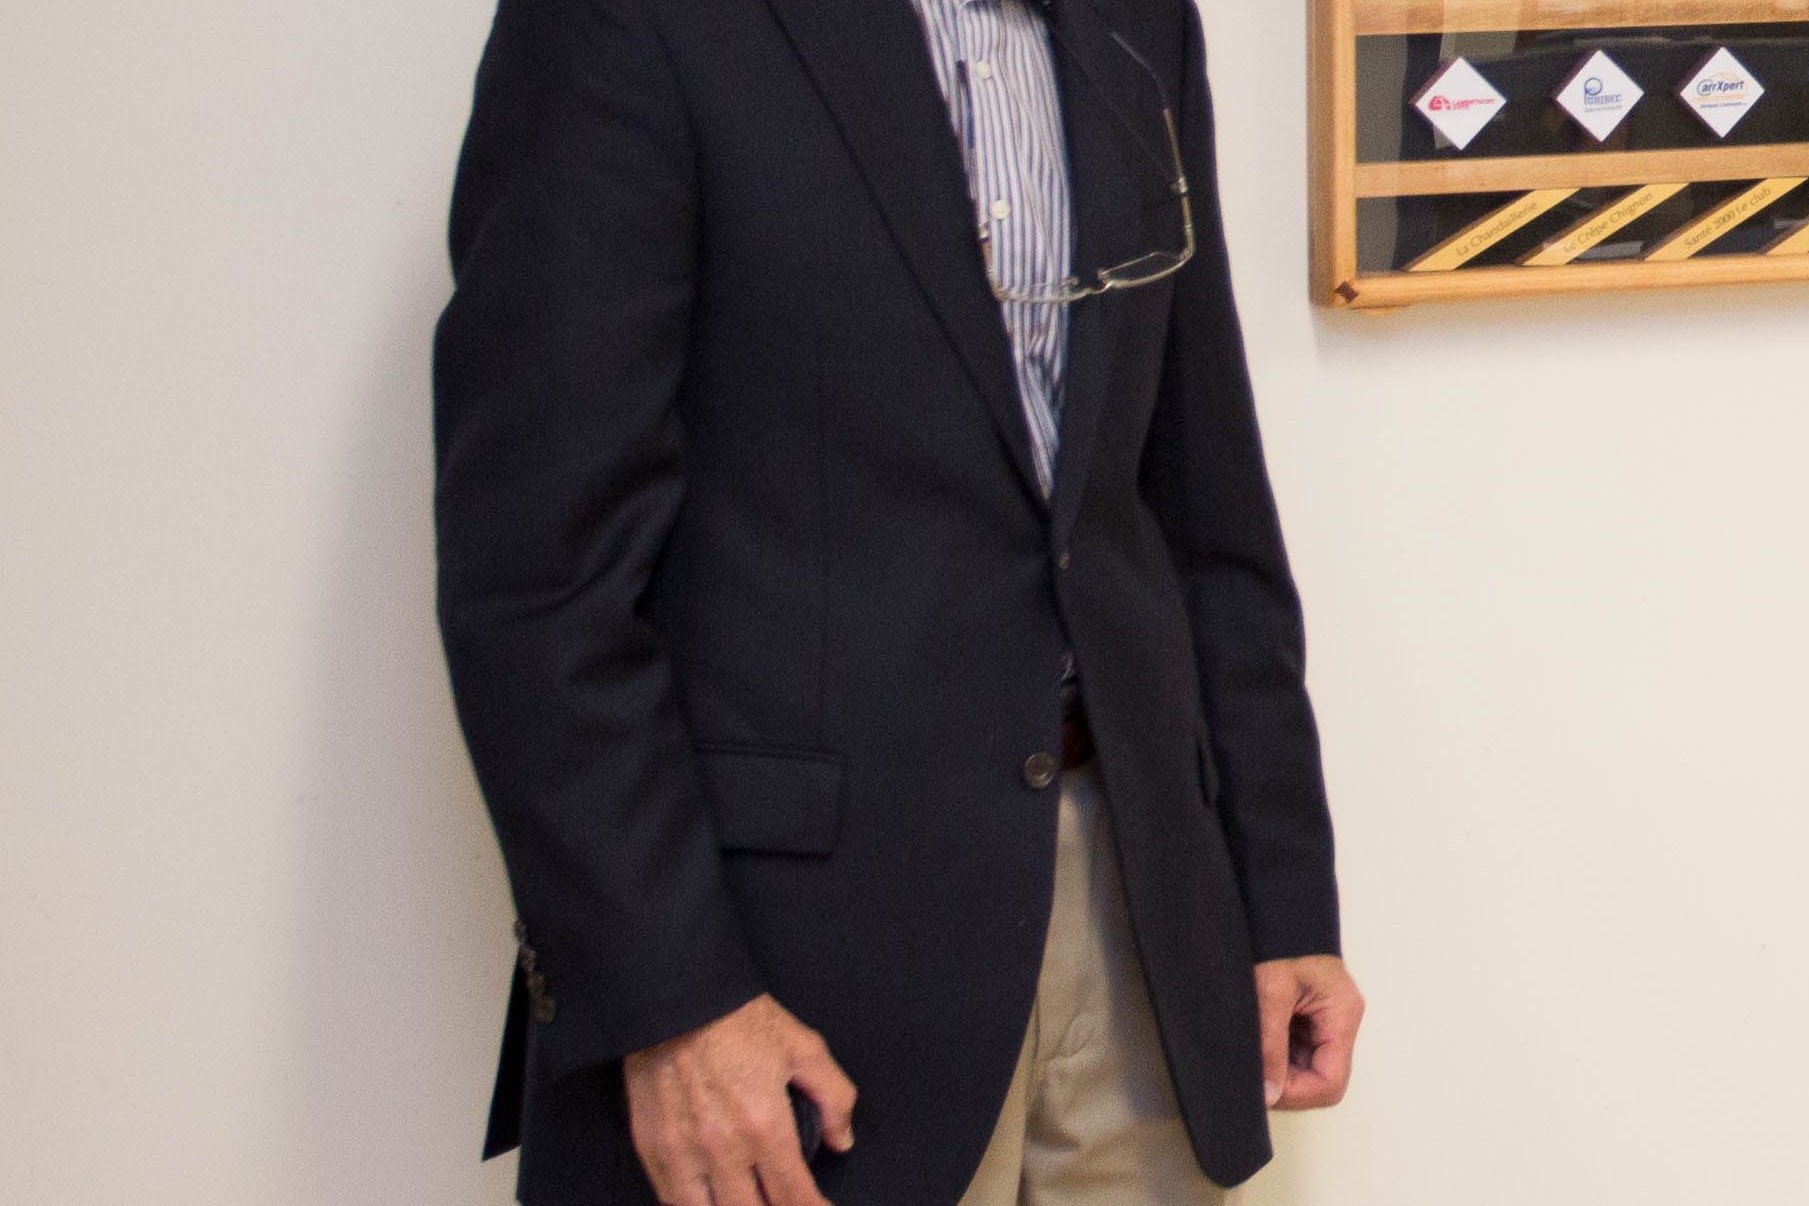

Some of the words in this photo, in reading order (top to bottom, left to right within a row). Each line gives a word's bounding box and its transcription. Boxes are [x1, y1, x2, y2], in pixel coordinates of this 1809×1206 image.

[1609, 193, 1652, 225] Chignon
[1736, 203, 1748, 215] Le
[1749, 187, 1773, 207] club
[1456, 245, 1469, 257] La
